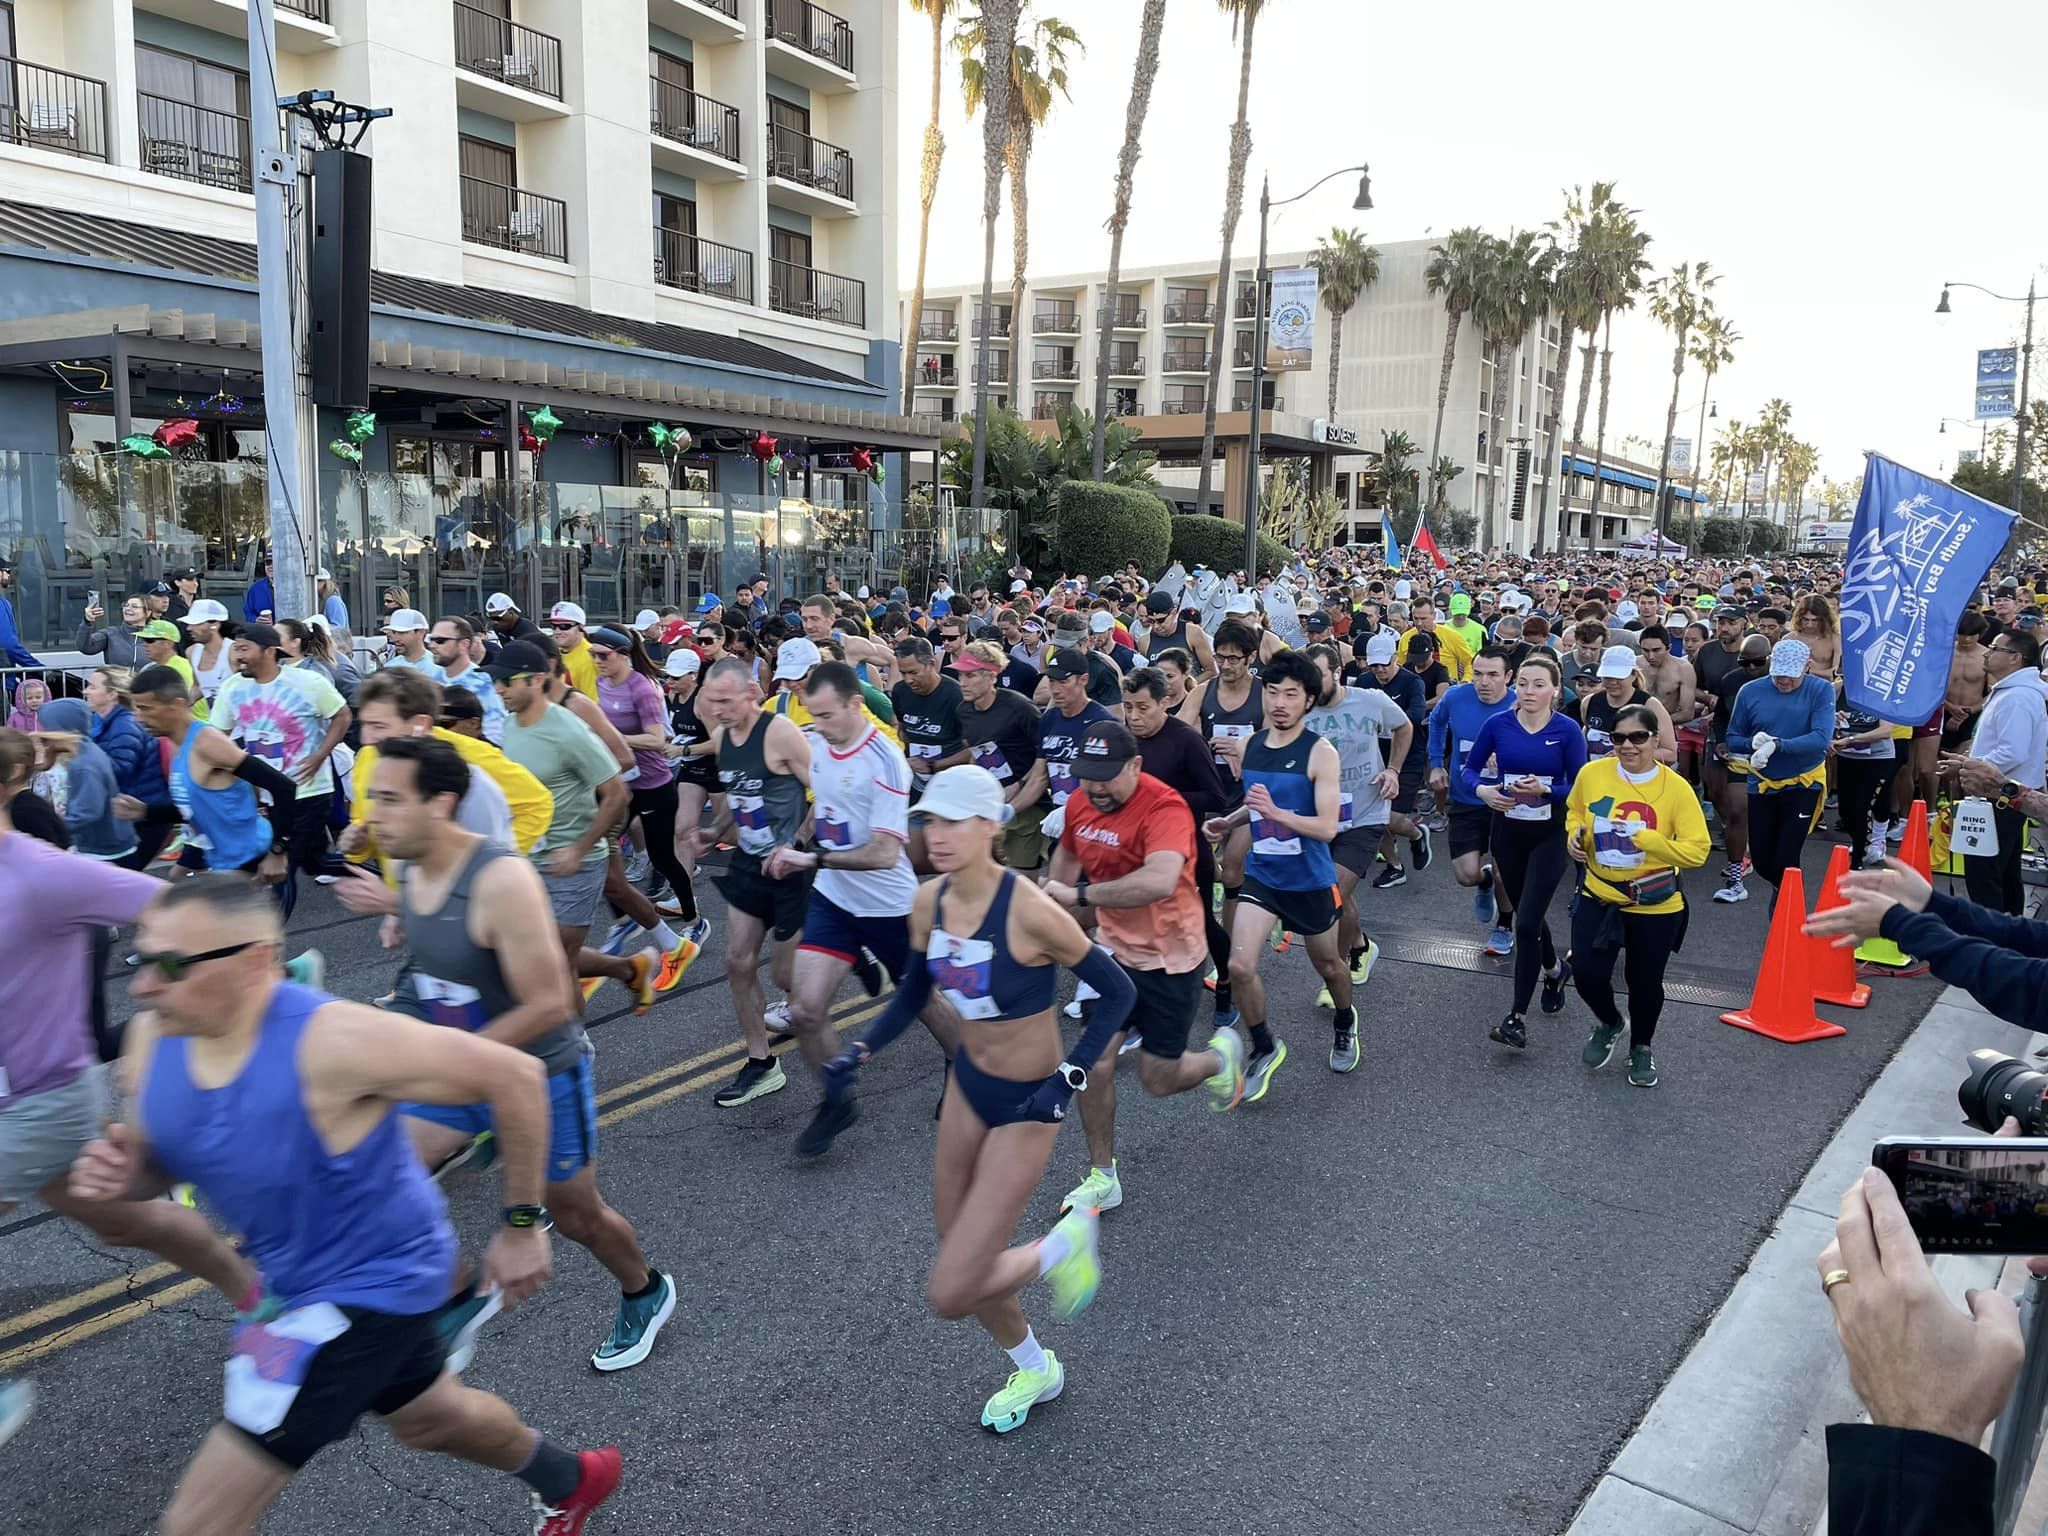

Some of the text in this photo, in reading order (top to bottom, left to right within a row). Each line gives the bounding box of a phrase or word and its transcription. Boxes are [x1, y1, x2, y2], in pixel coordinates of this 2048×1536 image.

[1978, 403, 2012, 412] EXPLORE
[1962, 816, 1986, 824] RING
[1960, 825, 1986, 833] BEER
